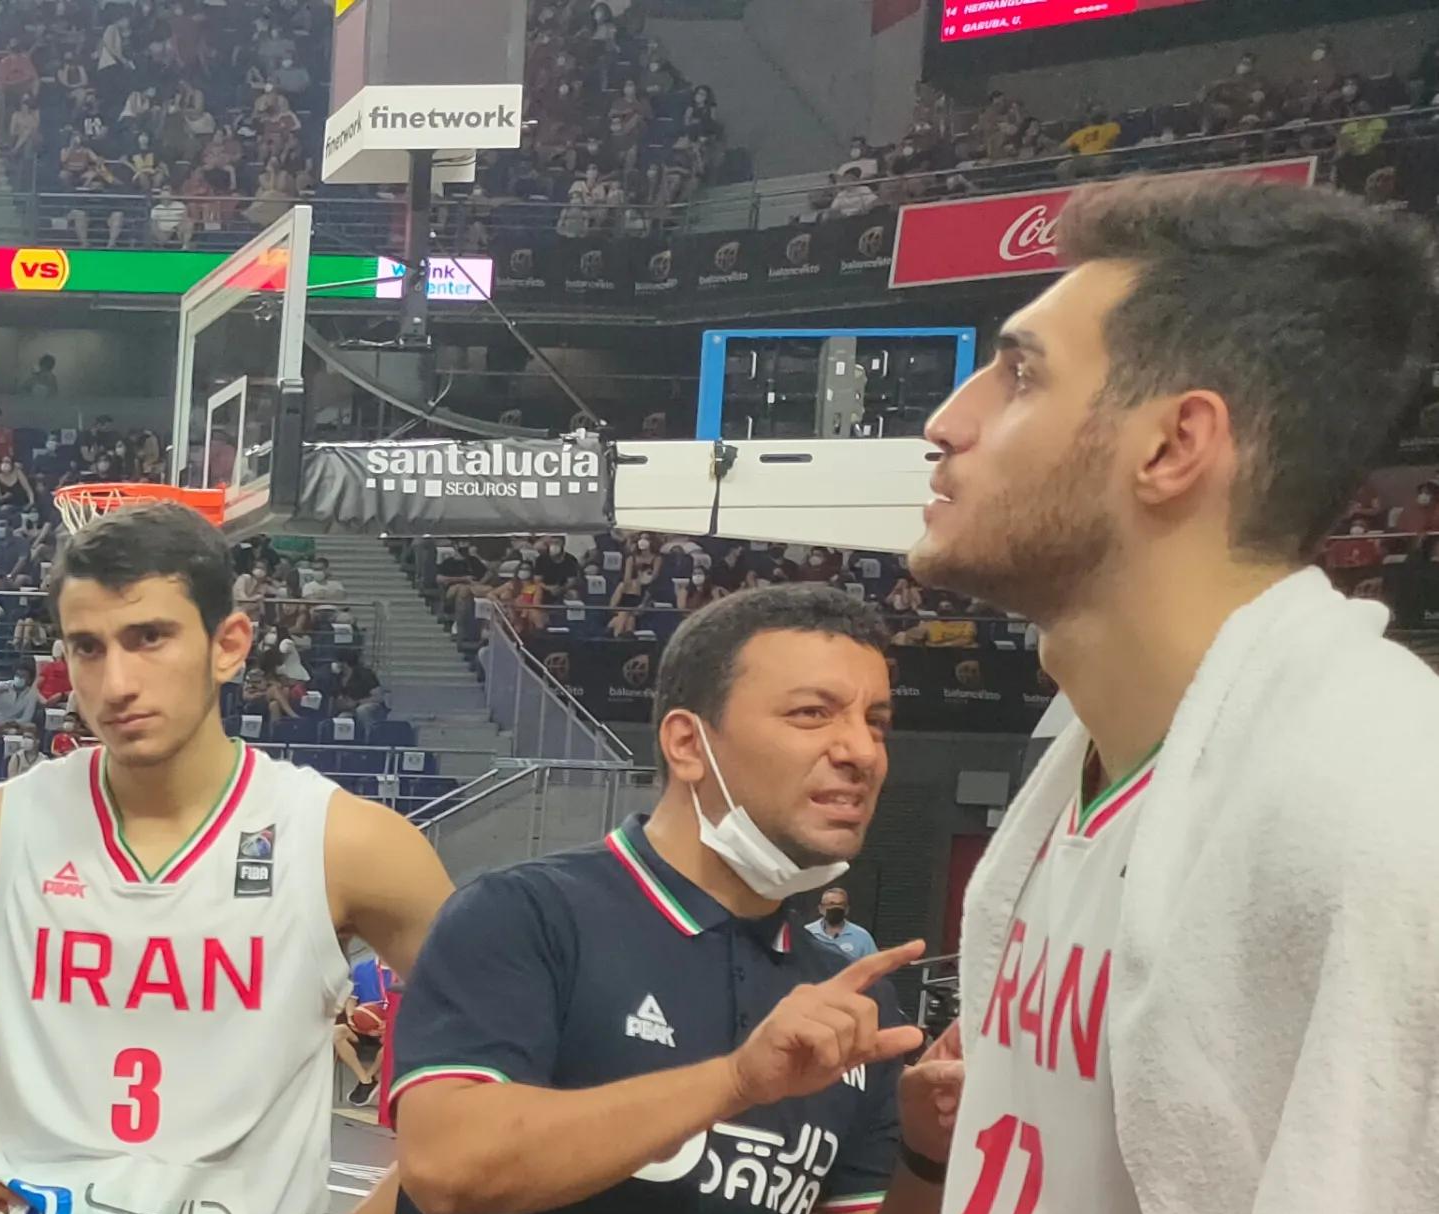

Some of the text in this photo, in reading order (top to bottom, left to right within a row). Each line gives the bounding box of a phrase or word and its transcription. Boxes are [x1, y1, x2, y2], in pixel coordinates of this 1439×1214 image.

[325, 110, 363, 159] finetwork
[369, 104, 516, 129] finetwork
[20, 261, 59, 279] VS
[427, 281, 472, 295] enter
[445, 481, 518, 497] SEGUROS
[30, 927, 264, 1013] IRAN
[980, 917, 1113, 1081] RAN
[110, 1047, 163, 1144] 3
